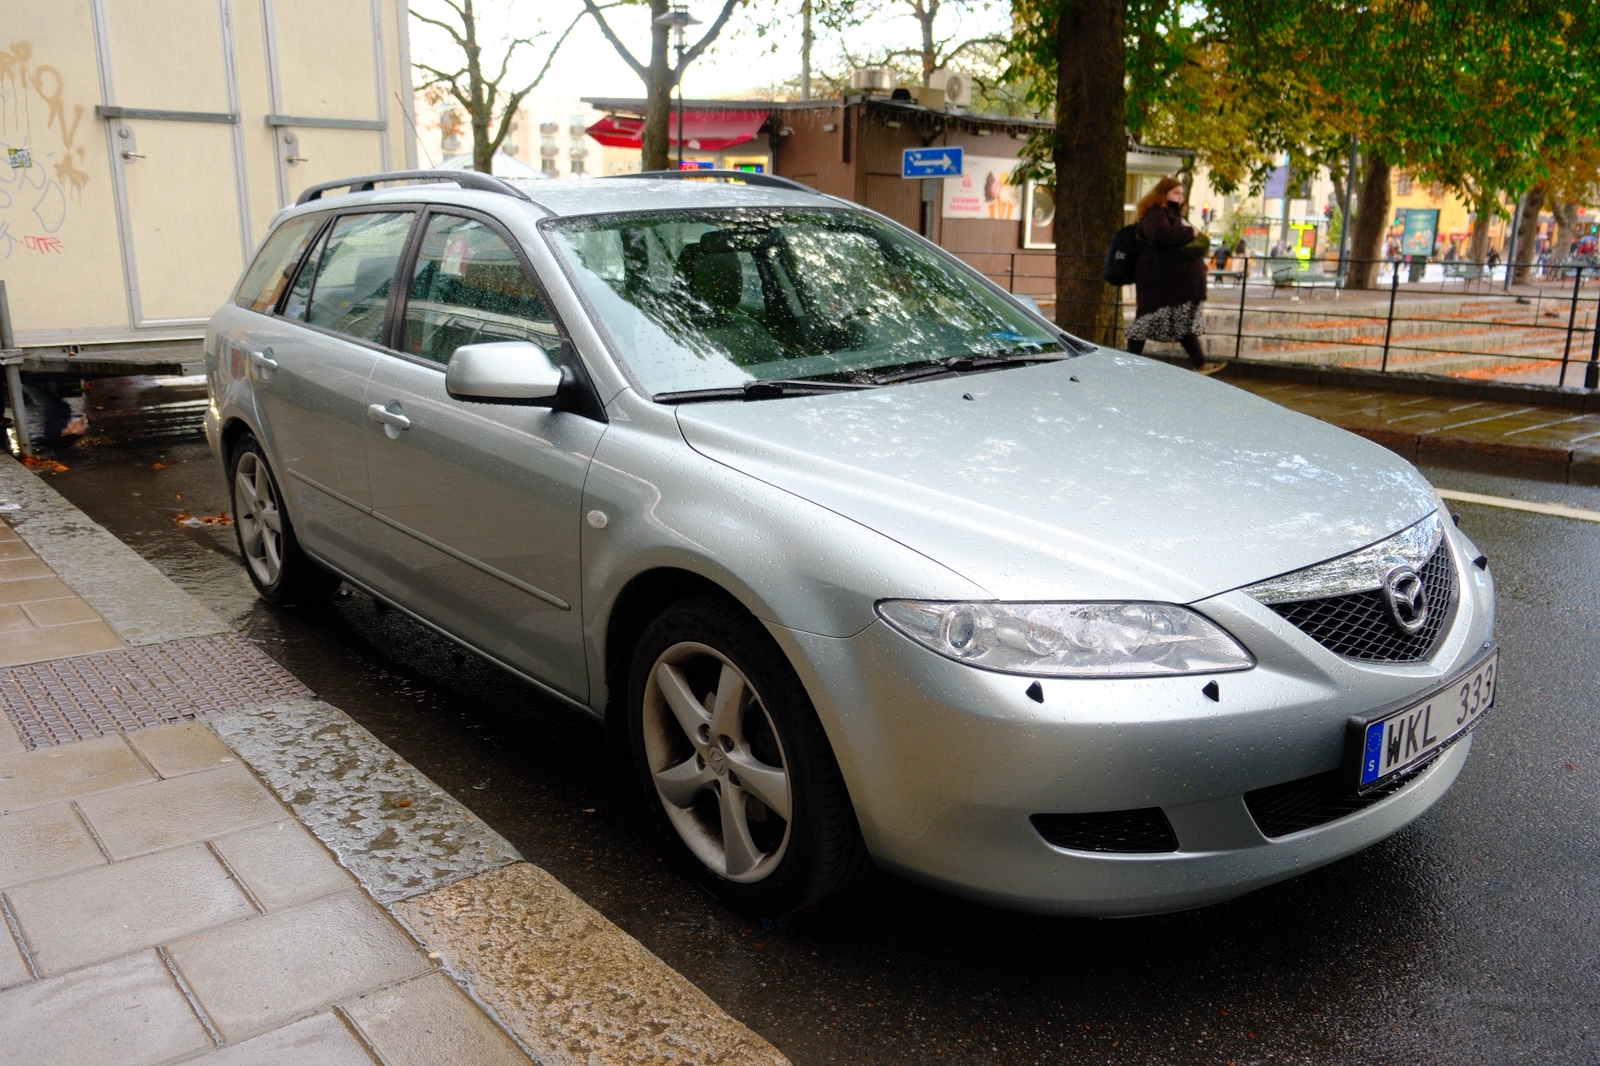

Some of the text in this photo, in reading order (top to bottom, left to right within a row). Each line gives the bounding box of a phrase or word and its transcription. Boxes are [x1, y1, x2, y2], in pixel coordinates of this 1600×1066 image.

[1386, 663, 1493, 768] WKL 333
[1368, 759, 1376, 772] S
